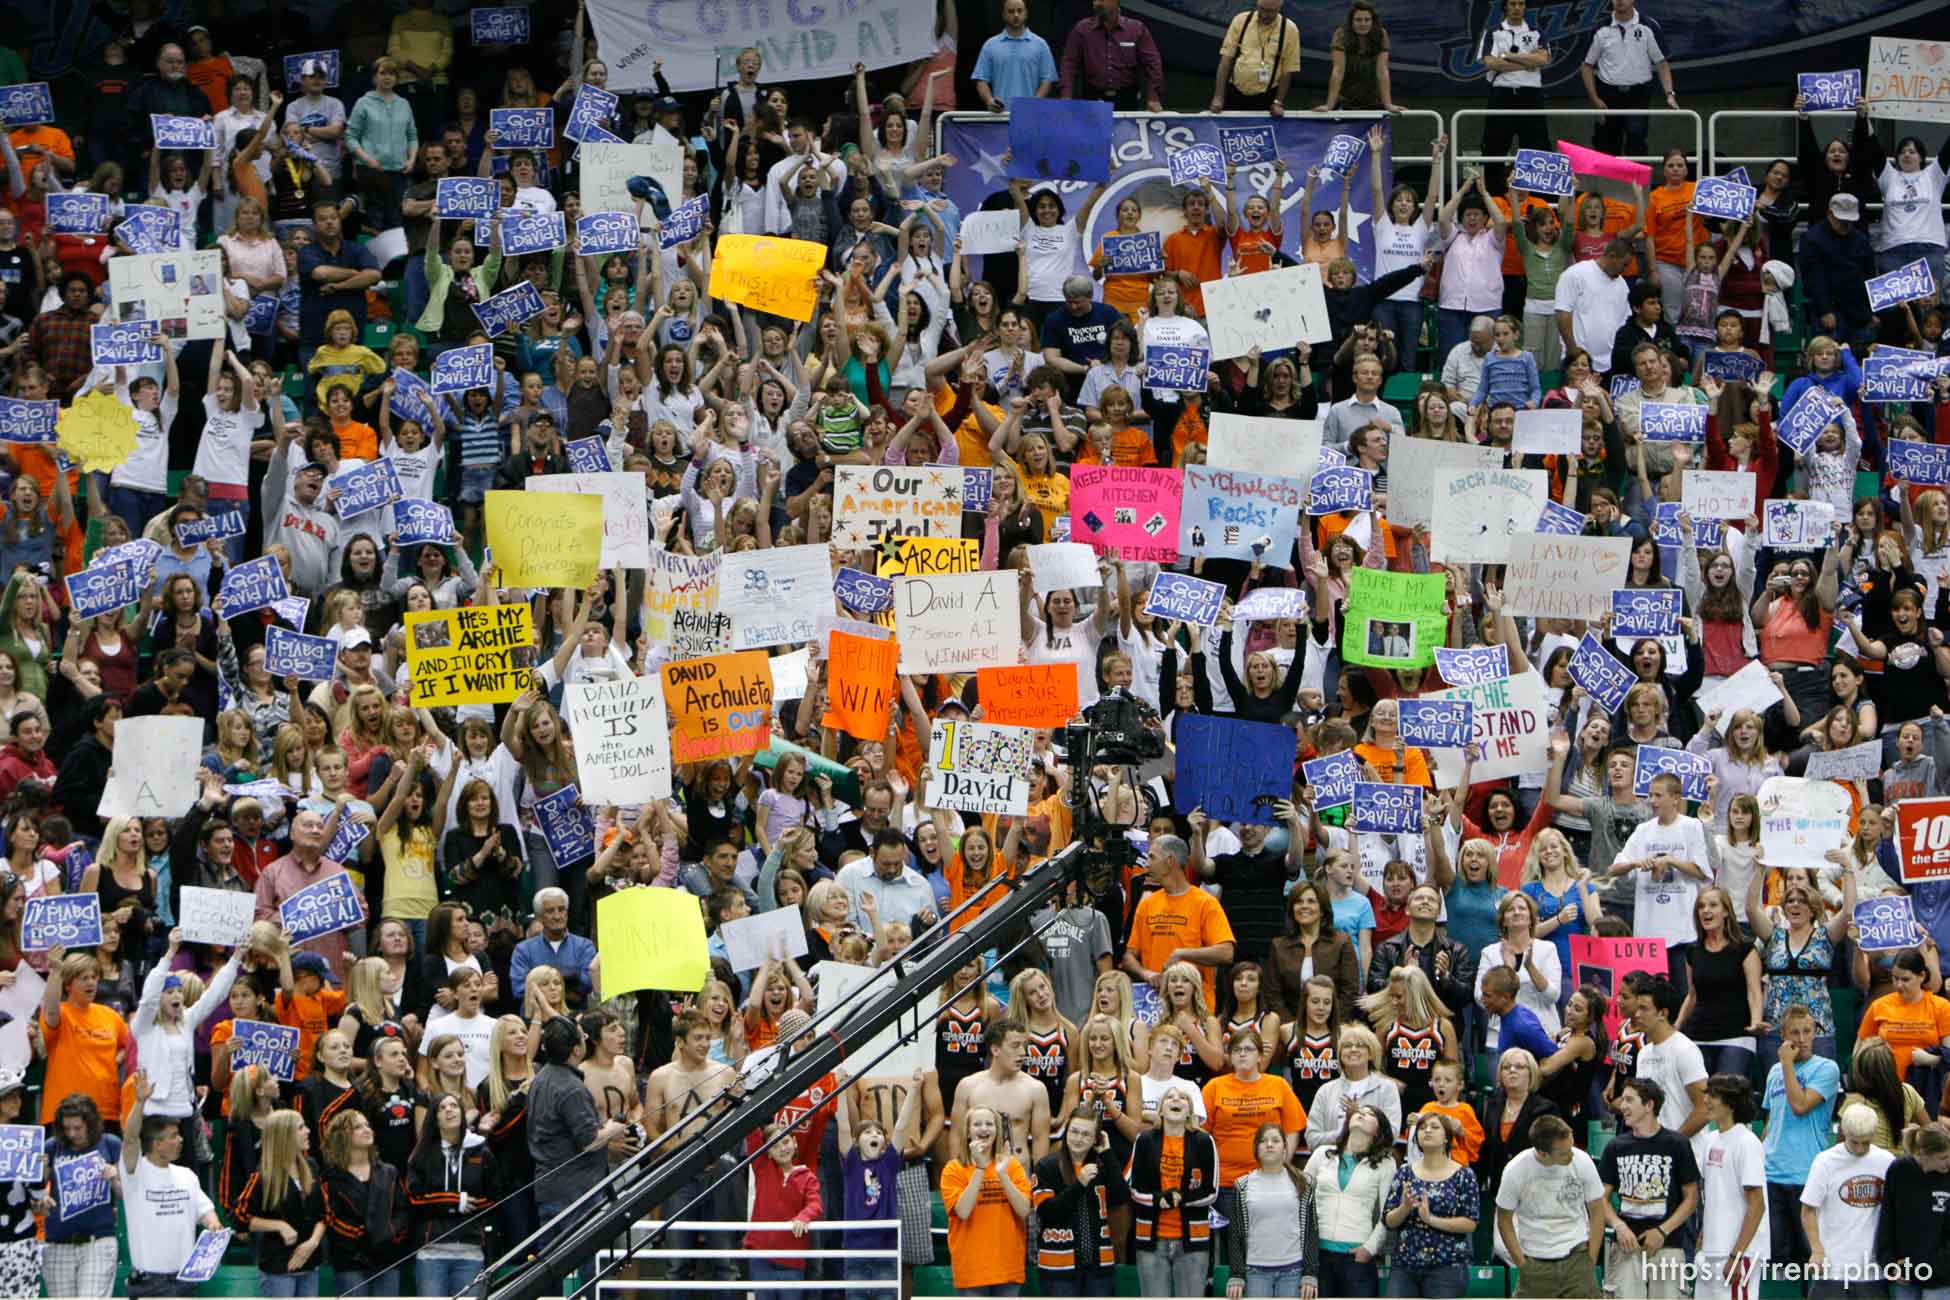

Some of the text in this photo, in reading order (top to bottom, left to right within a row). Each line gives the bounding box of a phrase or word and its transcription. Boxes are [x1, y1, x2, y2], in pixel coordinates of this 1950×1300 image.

[1803, 89, 1839, 104] David
[1067, 323, 1106, 337] Popcorn
[1073, 331, 1097, 345] Rock
[872, 468, 923, 496] Our
[1072, 469, 1163, 490] KEEP COOK IN
[1448, 472, 1487, 497] ARCH
[841, 494, 962, 517] American
[1101, 487, 1159, 504] KITCHEN
[1207, 496, 1279, 527] Rocks!
[903, 541, 980, 574] ARCHIE
[904, 575, 1002, 619] David A
[456, 607, 525, 630] HE'S MY
[674, 608, 732, 638] Archuleta
[1616, 611, 1678, 633] David A!
[458, 624, 525, 651] ARCHIE
[680, 636, 714, 653] SING
[415, 649, 510, 677] AND CRY
[924, 644, 1000, 668] WINNER!!
[418, 679, 438, 699] IF
[444, 674, 460, 695] I
[463, 671, 508, 692] WANT
[667, 662, 718, 687] DAVID
[583, 681, 641, 703] DAVID
[684, 675, 772, 715] Archuleta
[839, 678, 887, 714] WIN
[603, 714, 638, 739] IS
[701, 716, 720, 736] is
[1403, 723, 1470, 745] David A!
[1472, 709, 1537, 738] STAND
[584, 744, 655, 767] AMERICAN
[1497, 736, 1520, 758] ME
[136, 780, 163, 808] A
[942, 771, 1013, 803] David
[1357, 806, 1419, 830] David A!
[1912, 854, 1932, 866] the
[1614, 942, 1658, 959] LOVE
